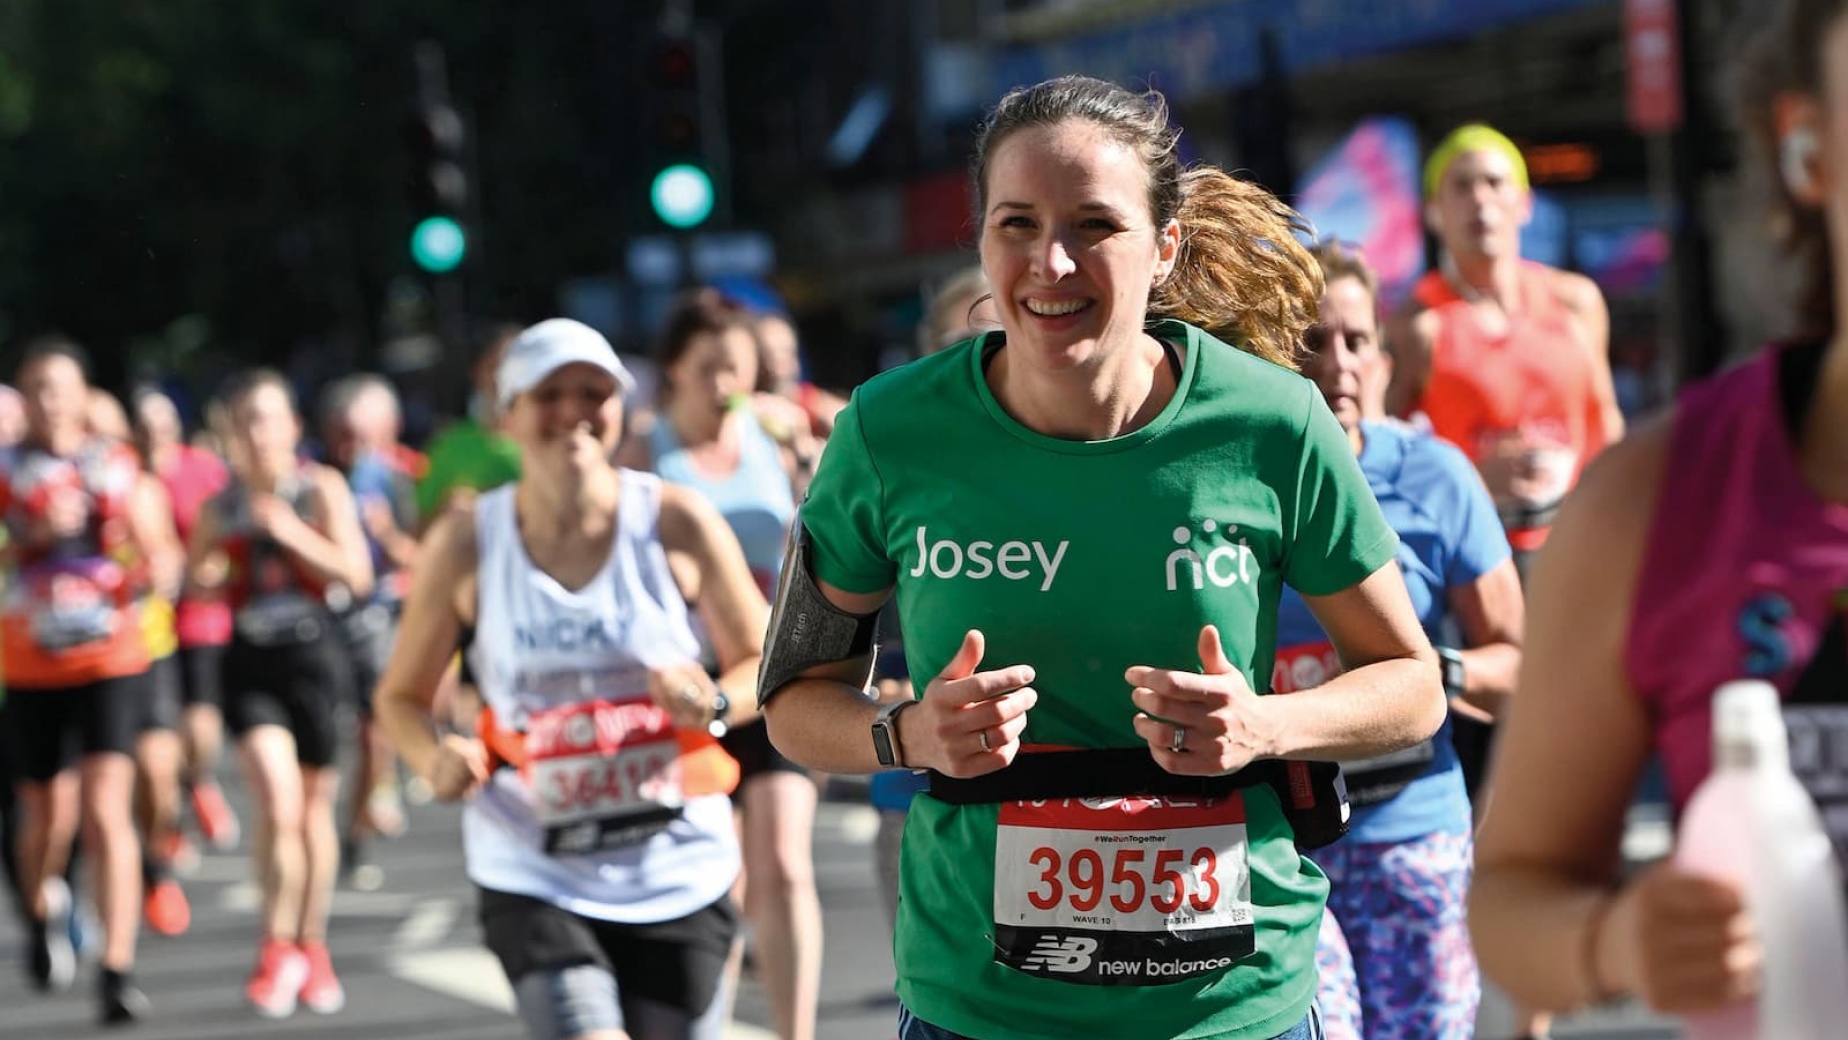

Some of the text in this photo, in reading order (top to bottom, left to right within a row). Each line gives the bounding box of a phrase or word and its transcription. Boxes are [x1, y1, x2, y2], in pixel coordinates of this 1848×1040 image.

[911, 526, 1070, 591] Josey
[1094, 834, 1168, 844] #WeRunTogether
[1027, 846, 1220, 914] 39553
[1072, 915, 1111, 925] WAVE 10
[1098, 957, 1232, 977] new balance
